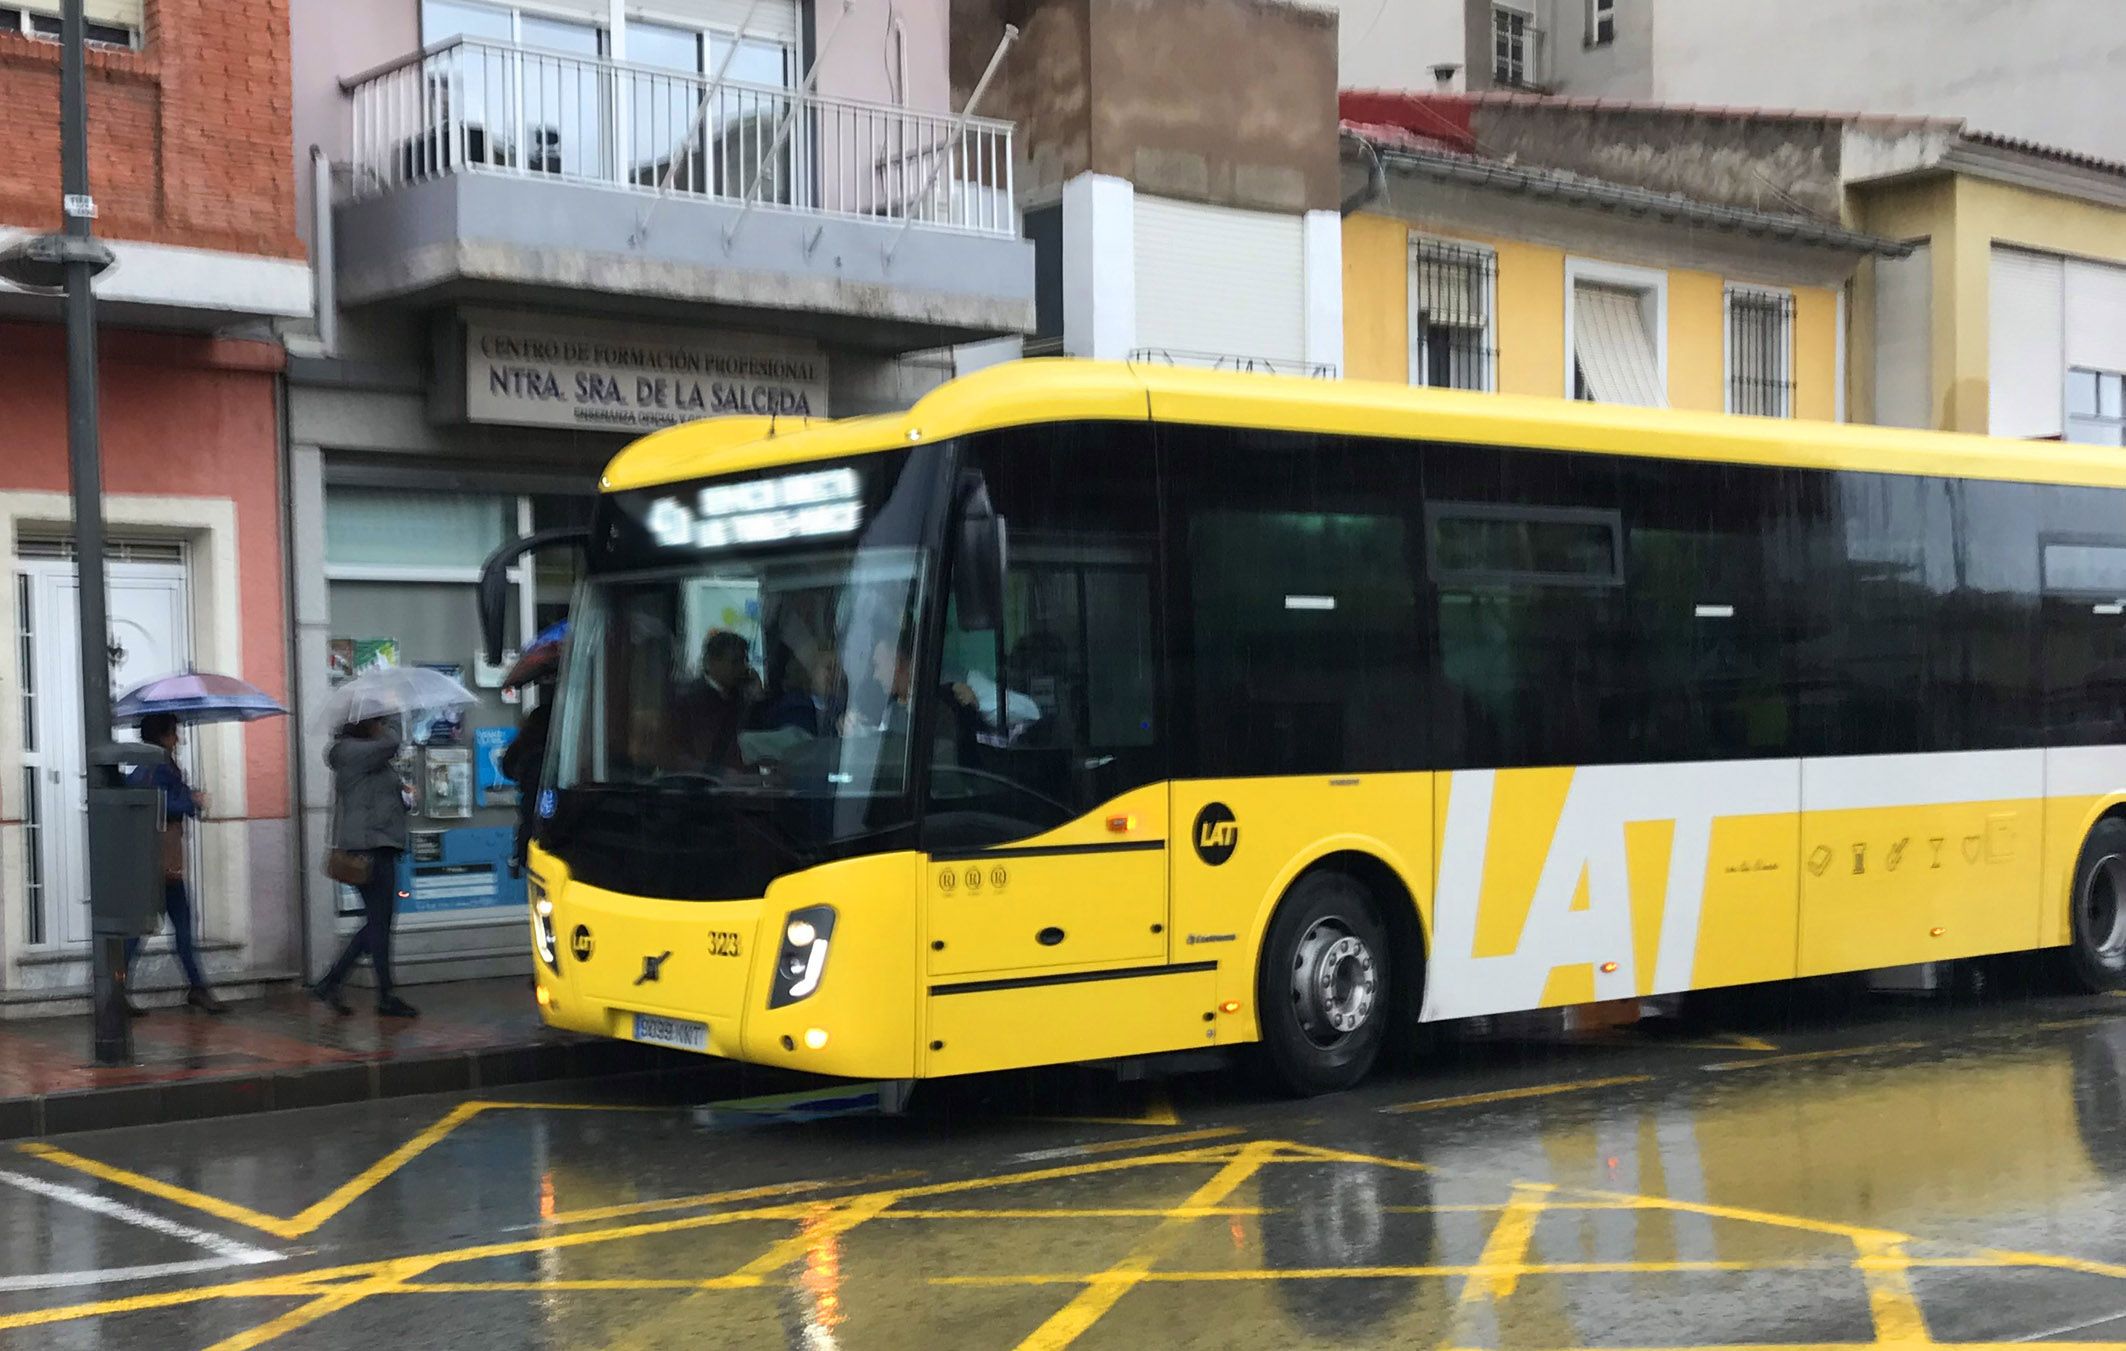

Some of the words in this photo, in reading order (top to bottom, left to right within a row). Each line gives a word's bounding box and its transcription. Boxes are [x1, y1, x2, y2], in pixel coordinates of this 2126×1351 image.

[480, 335, 558, 362] CENTRO
[564, 341, 589, 362] DE
[593, 343, 699, 373] FORMACIÓN
[705, 352, 815, 380] PROFESIONAL
[489, 364, 567, 402] NTRA.
[574, 369, 628, 406] SRA.
[636, 375, 668, 408] DE
[675, 379, 705, 411] LA
[710, 382, 811, 416] SALCEDA
[1200, 819, 1239, 848] LAT
[1418, 765, 1714, 1023] LAT
[707, 930, 739, 957] 323
